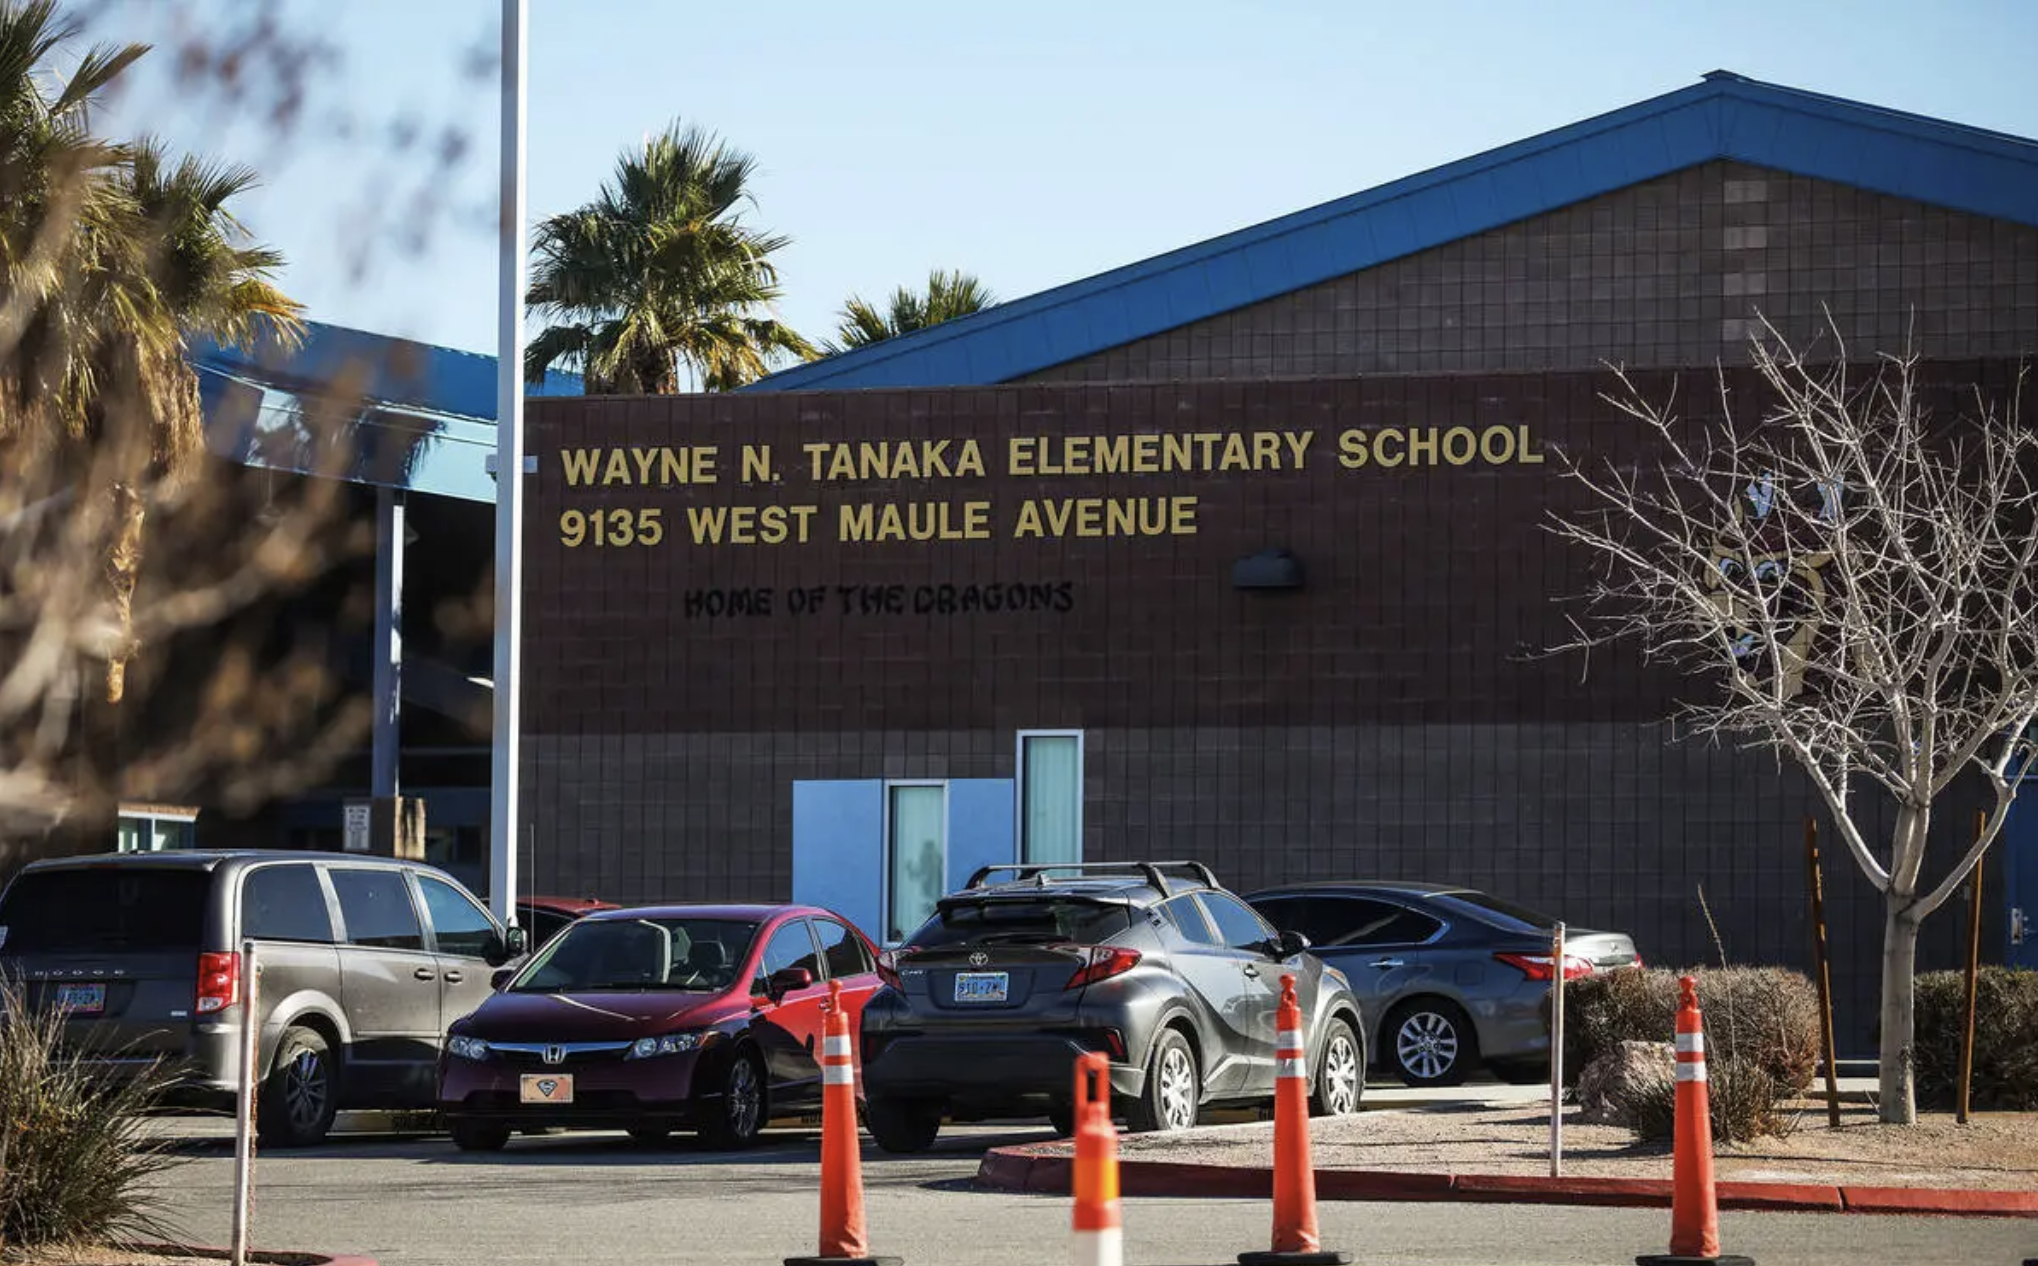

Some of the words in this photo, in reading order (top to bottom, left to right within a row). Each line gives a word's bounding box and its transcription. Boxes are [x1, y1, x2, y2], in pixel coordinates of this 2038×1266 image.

[561, 446, 718, 487] WAYNE
[742, 445, 782, 483] N.
[803, 439, 985, 481] TANAKA
[1009, 433, 1313, 475] ELEMENTARY
[1339, 425, 1544, 468] SCHOOL
[560, 508, 664, 548] 9135
[687, 506, 818, 545] WEST
[839, 501, 990, 543] MAULE
[1014, 496, 1197, 538] AVENUE
[684, 587, 775, 618] HOME
[787, 585, 827, 615] OF
[836, 583, 905, 615] THE
[914, 580, 1074, 614] DRAGONS
